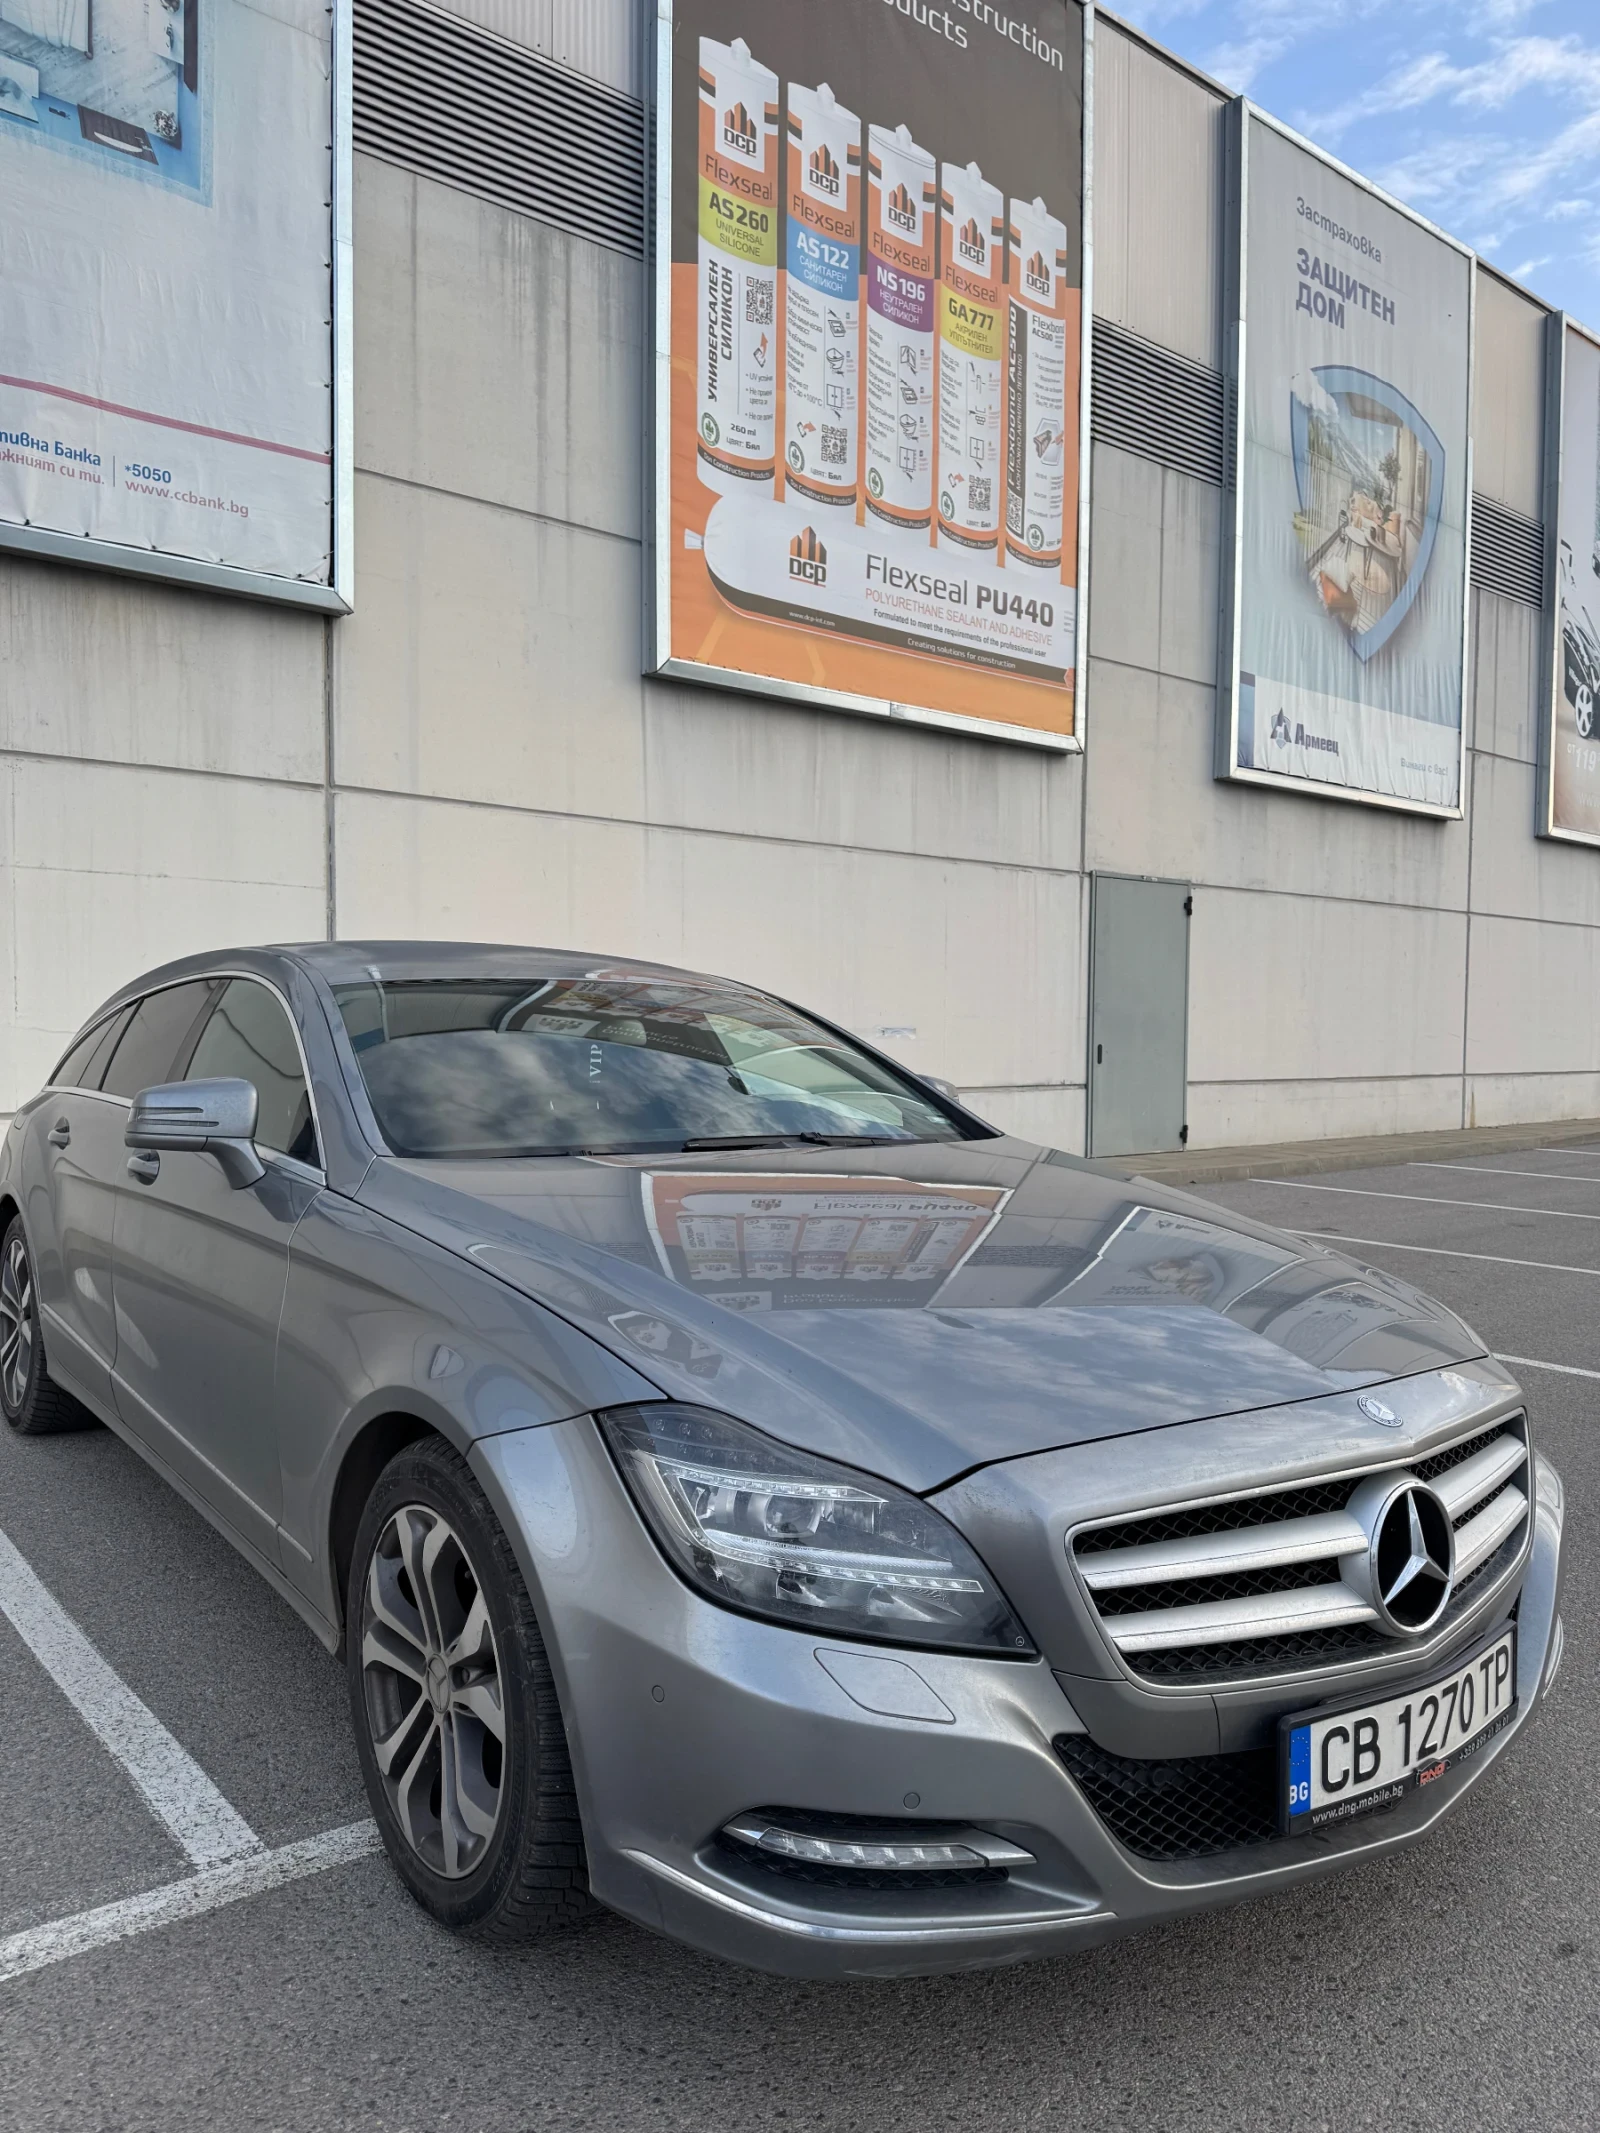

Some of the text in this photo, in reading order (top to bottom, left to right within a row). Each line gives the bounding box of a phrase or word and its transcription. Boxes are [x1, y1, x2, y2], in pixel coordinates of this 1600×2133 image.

[951, 0, 1063, 71] struction
[724, 127, 757, 156] DCP
[705, 153, 772, 201] Flexseal
[809, 167, 840, 195] DCP
[792, 194, 855, 238] Flexseal
[888, 207, 916, 232] DCP
[1297, 197, 1382, 264] Застраховка
[715, 217, 764, 246] UNIVERSAL
[719, 232, 761, 257] SILICONE
[872, 232, 930, 273] Flexseal
[959, 241, 985, 265] DCP
[799, 254, 847, 284] САНИТАРЕН
[803, 270, 842, 293] СИЛИКОН
[945, 265, 998, 303] Flexseal
[1026, 272, 1050, 296] DCP
[1297, 248, 1395, 326] ЗАЩИТЕН
[721, 266, 732, 361] СИЛИКОН
[879, 288, 923, 315] НЕУТРАЛЕН
[882, 303, 920, 324] СИЛИКОН
[948, 297, 994, 331] GA777
[1296, 281, 1345, 330] ДОМ
[708, 259, 718, 402] УНИВЕРСАЛЕН
[954, 322, 988, 343] АКРИЛЕН
[1031, 327, 1054, 342] AC500
[1008, 305, 1018, 486] Flexbond AC500
[731, 423, 756, 436] 260 ml
[54, 440, 101, 467] Банка
[745, 441, 760, 451] Бял
[59, 465, 76, 478] си
[79, 470, 105, 485] ти.
[713, 459, 749, 479] Construction
[828, 471, 842, 481] Бял
[125, 480, 249, 518] www.ccbank.bg
[789, 557, 827, 586] DCP
[866, 553, 968, 606] Flexseal
[976, 585, 1054, 628] PU440
[865, 587, 1052, 646] POLYURETHANE SEALANT AND ADHESIVE
[873, 608, 1047, 659] Formulated to meet the requirements of the professional user
[907, 638, 1017, 669] Creating solutions for construction
[1295, 722, 1340, 757] Армеец
[1400, 757, 1426, 773] Винаги
[1434, 764, 1449, 777] вас!
[1576, 747, 1597, 773] 119
[589, 1044, 602, 1077] VIP
[1398, 1672, 1475, 1767] 1270
[1289, 1782, 1310, 1805] BG
[1312, 1784, 1404, 1825] www.dng.mobile.bg
